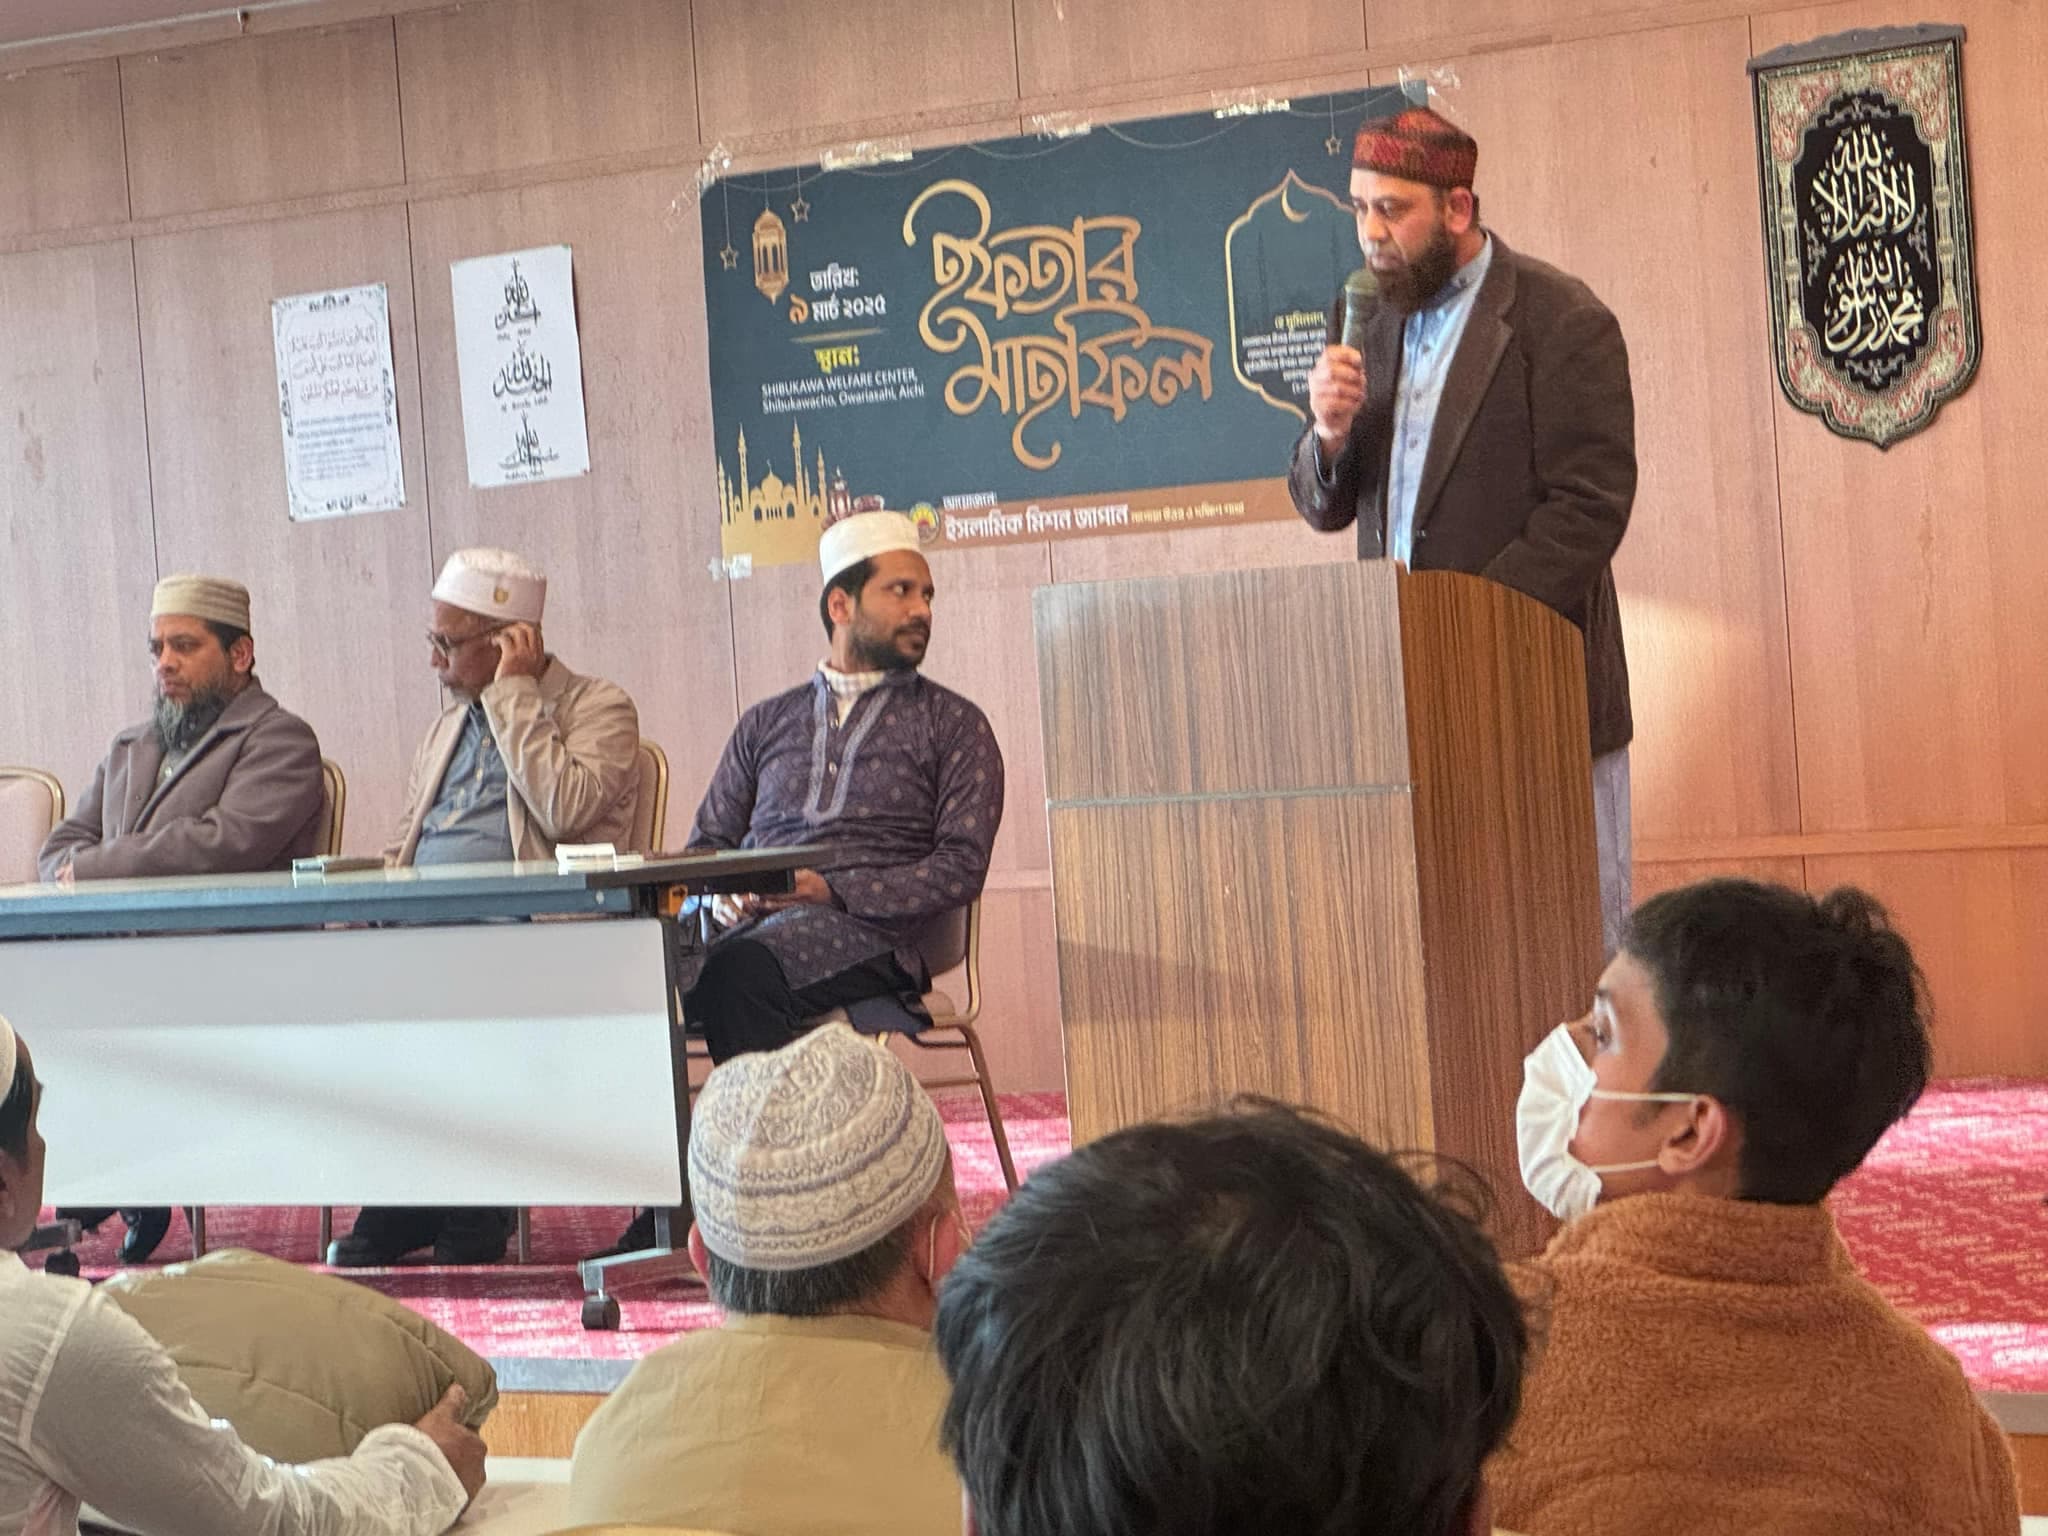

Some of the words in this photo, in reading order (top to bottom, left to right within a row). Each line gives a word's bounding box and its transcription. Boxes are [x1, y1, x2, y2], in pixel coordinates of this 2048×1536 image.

[809, 262, 859, 292] তারিখ:
[903, 179, 1141, 352] ইফতার
[789, 293, 808, 325] ৯
[811, 292, 840, 323] মার্চ
[842, 293, 887, 319] ২০২৫
[814, 344, 860, 374] স্থান:
[761, 377, 824, 398] SHIBUKAWA
[825, 372, 873, 391] WELFARE
[875, 367, 918, 385] CENTER,
[762, 392, 837, 414] Shibukawacho,
[899, 382, 925, 399] Aichi
[937, 300, 1213, 470] মাহফিল
[945, 508, 1023, 542] ইসলামিক
[1026, 504, 1072, 533] মিশন
[1073, 503, 1129, 529] জাপান
